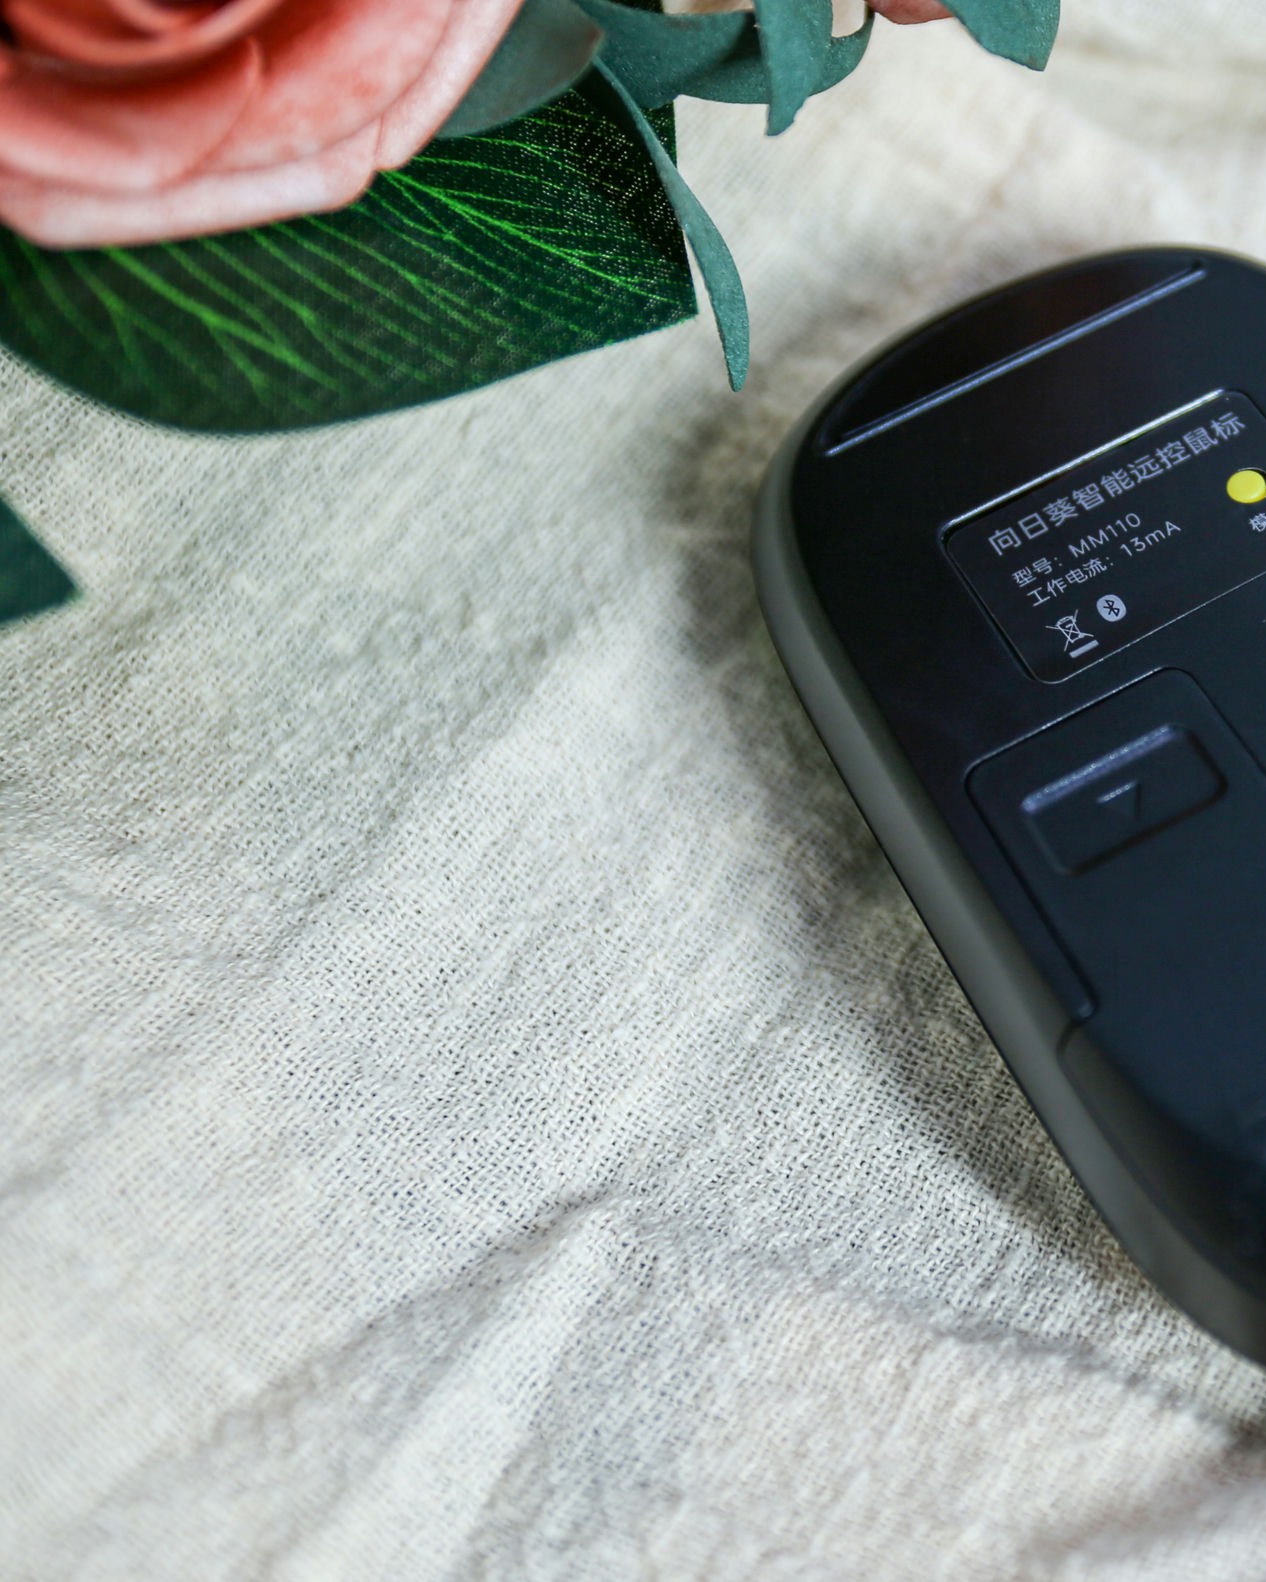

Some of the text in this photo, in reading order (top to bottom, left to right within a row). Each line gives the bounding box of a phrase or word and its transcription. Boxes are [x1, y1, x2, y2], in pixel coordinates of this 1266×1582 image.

[988, 412, 1245, 555] 向日葵智能远控鼠标
[1068, 512, 1141, 557] MM110
[1119, 520, 1181, 557] 13mA
